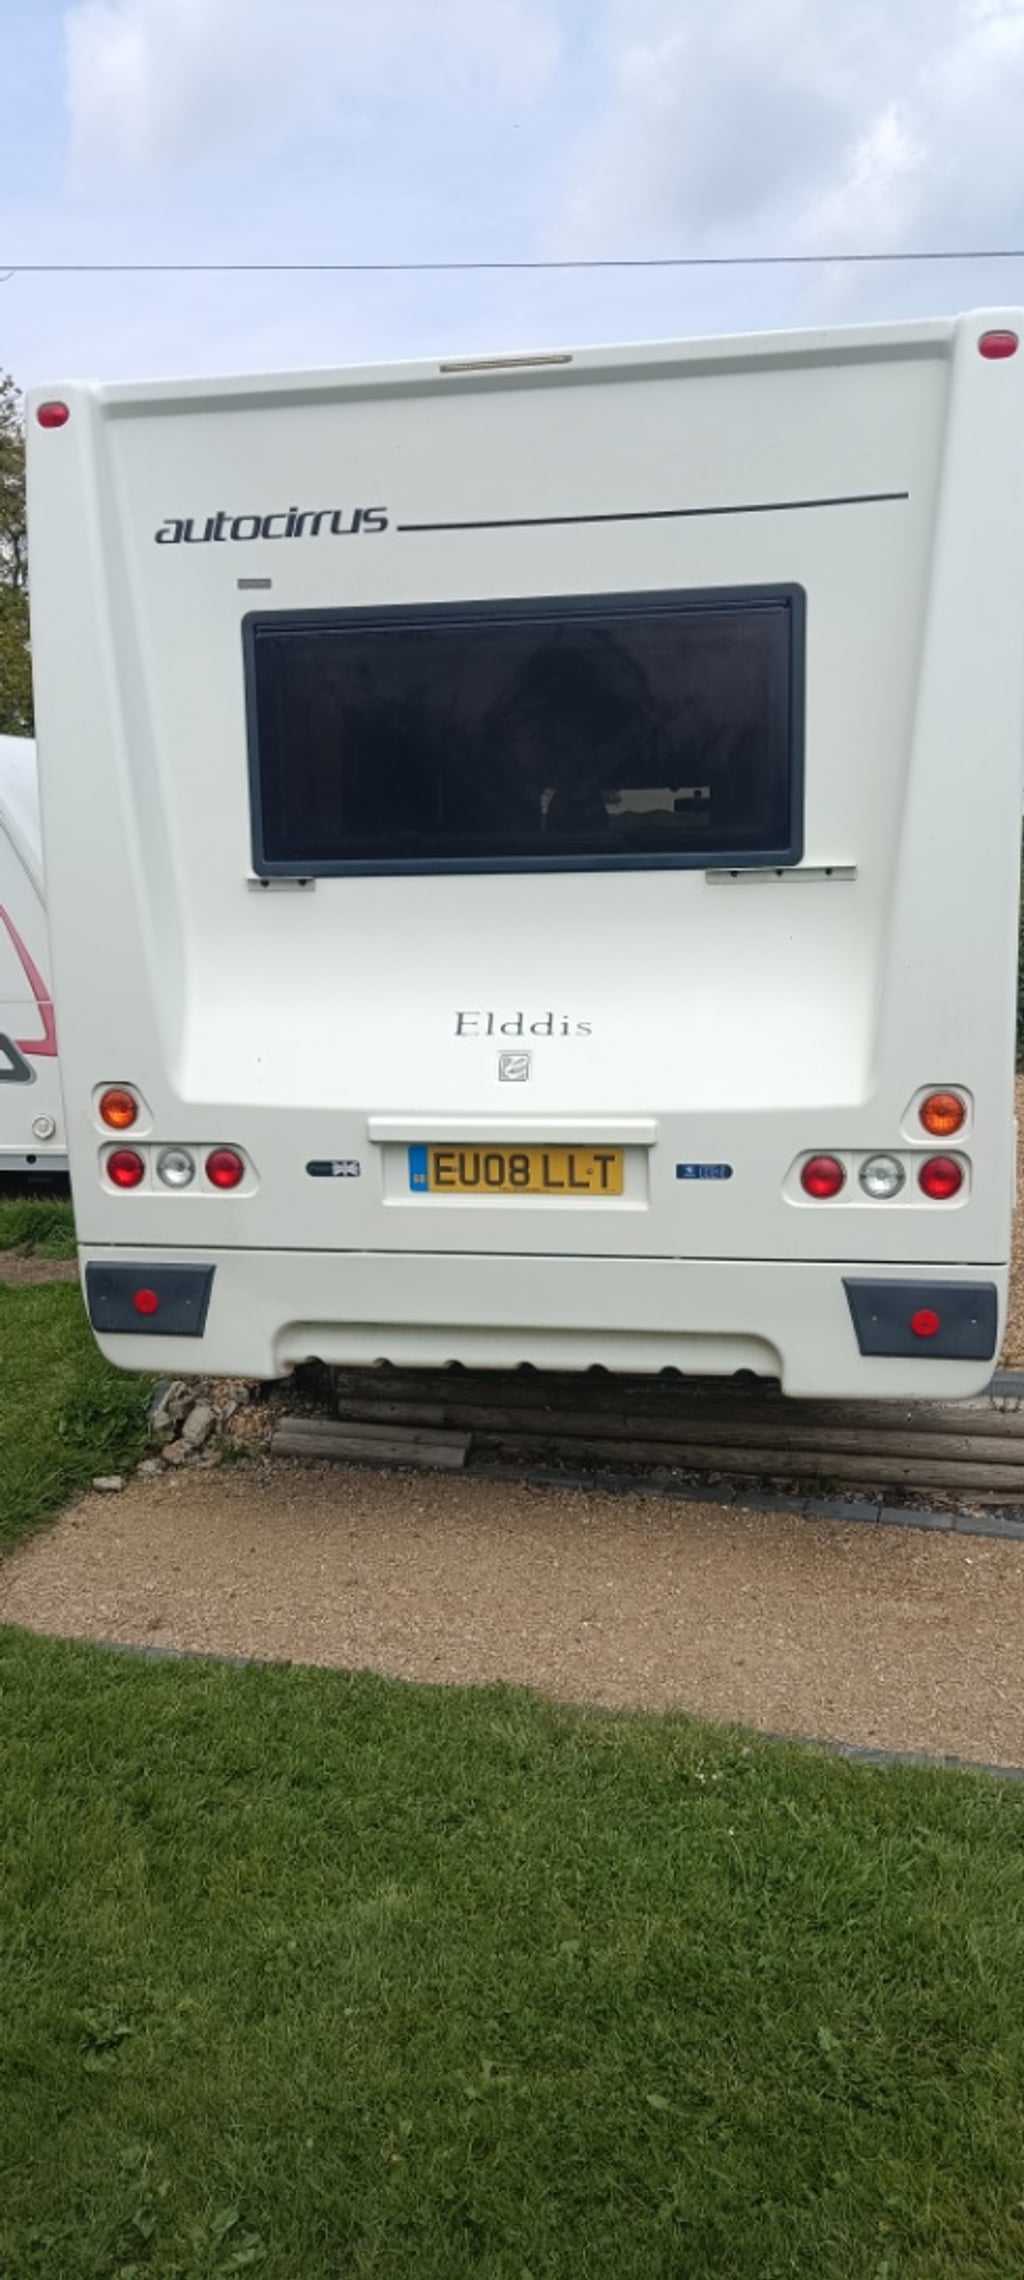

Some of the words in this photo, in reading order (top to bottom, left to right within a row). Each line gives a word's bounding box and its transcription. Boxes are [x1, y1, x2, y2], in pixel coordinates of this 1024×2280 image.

[154, 506, 389, 544] autocirrus
[454, 1011, 592, 1036] Elddis
[433, 1152, 531, 1187] EU08
[543, 1154, 615, 1188] LLT
